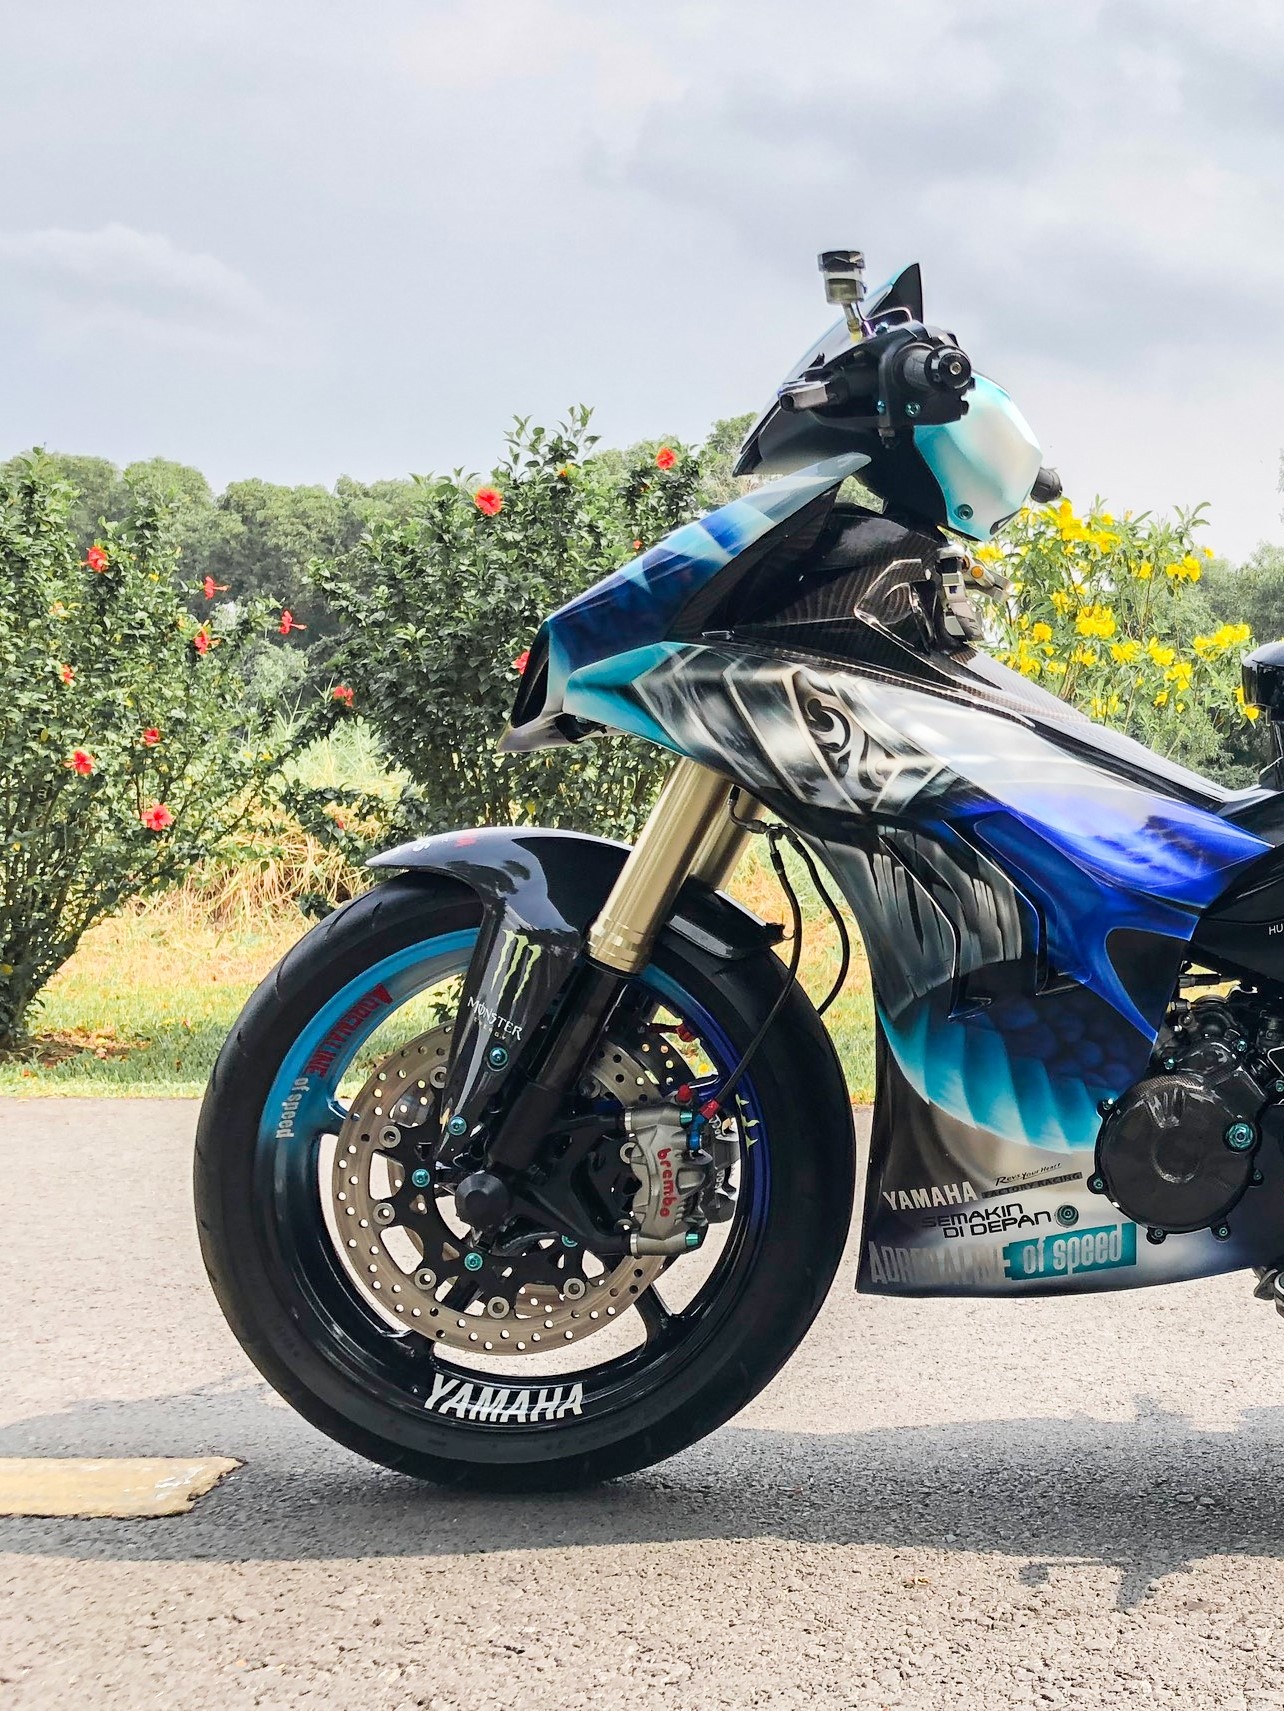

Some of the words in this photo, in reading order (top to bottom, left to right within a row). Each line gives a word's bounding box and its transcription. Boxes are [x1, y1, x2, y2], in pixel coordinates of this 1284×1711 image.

[467, 997, 522, 1041] MONSTER
[275, 1093, 303, 1138] speed
[657, 1148, 678, 1218] brembo
[882, 1181, 979, 1211] YAMAHA
[921, 1203, 1024, 1228] SEMAKIN
[943, 1225, 965, 1238] DI
[970, 1211, 1052, 1236] DEPAN
[1022, 1236, 1048, 1274] of
[1052, 1223, 1123, 1275] speed
[424, 1373, 583, 1423] YAMAHA
